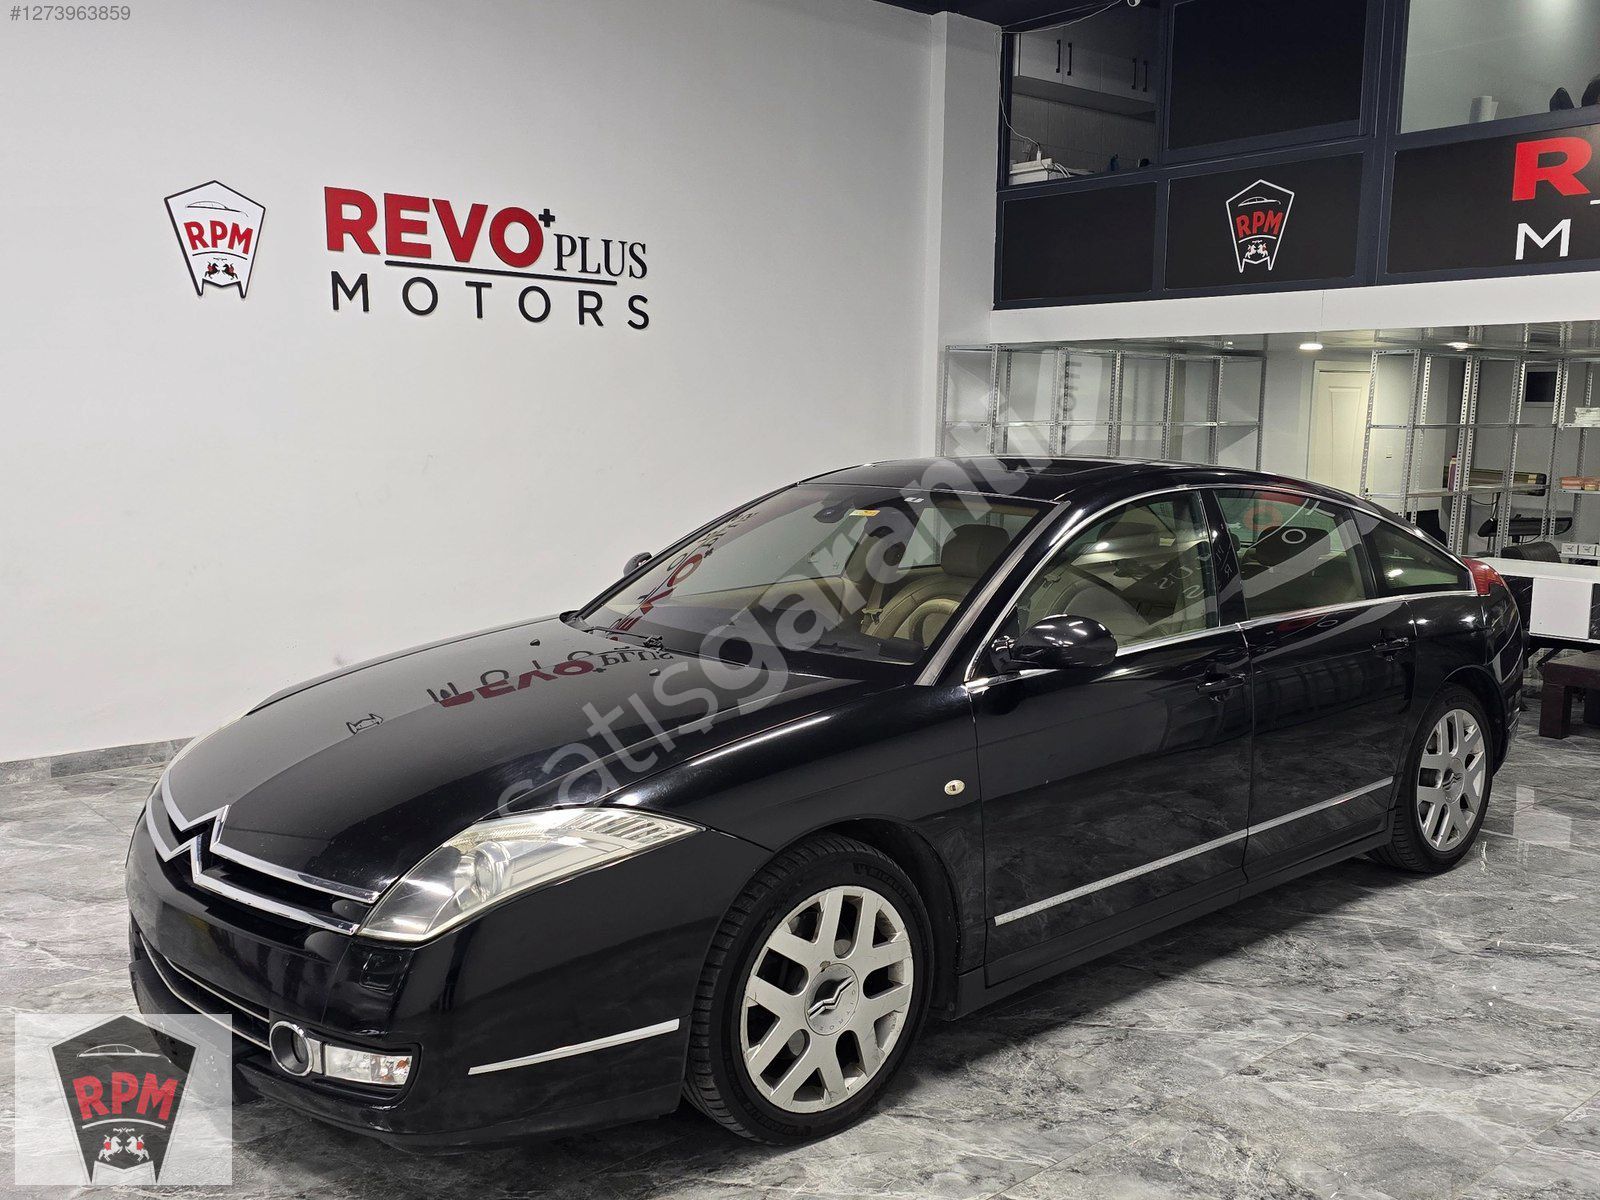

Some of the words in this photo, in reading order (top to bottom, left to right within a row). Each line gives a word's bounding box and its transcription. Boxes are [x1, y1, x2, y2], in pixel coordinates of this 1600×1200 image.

[183, 220, 254, 255] RPM
[1235, 209, 1283, 239] RPM
[553, 233, 648, 279] PLUS
[331, 270, 650, 330] MOTORS
